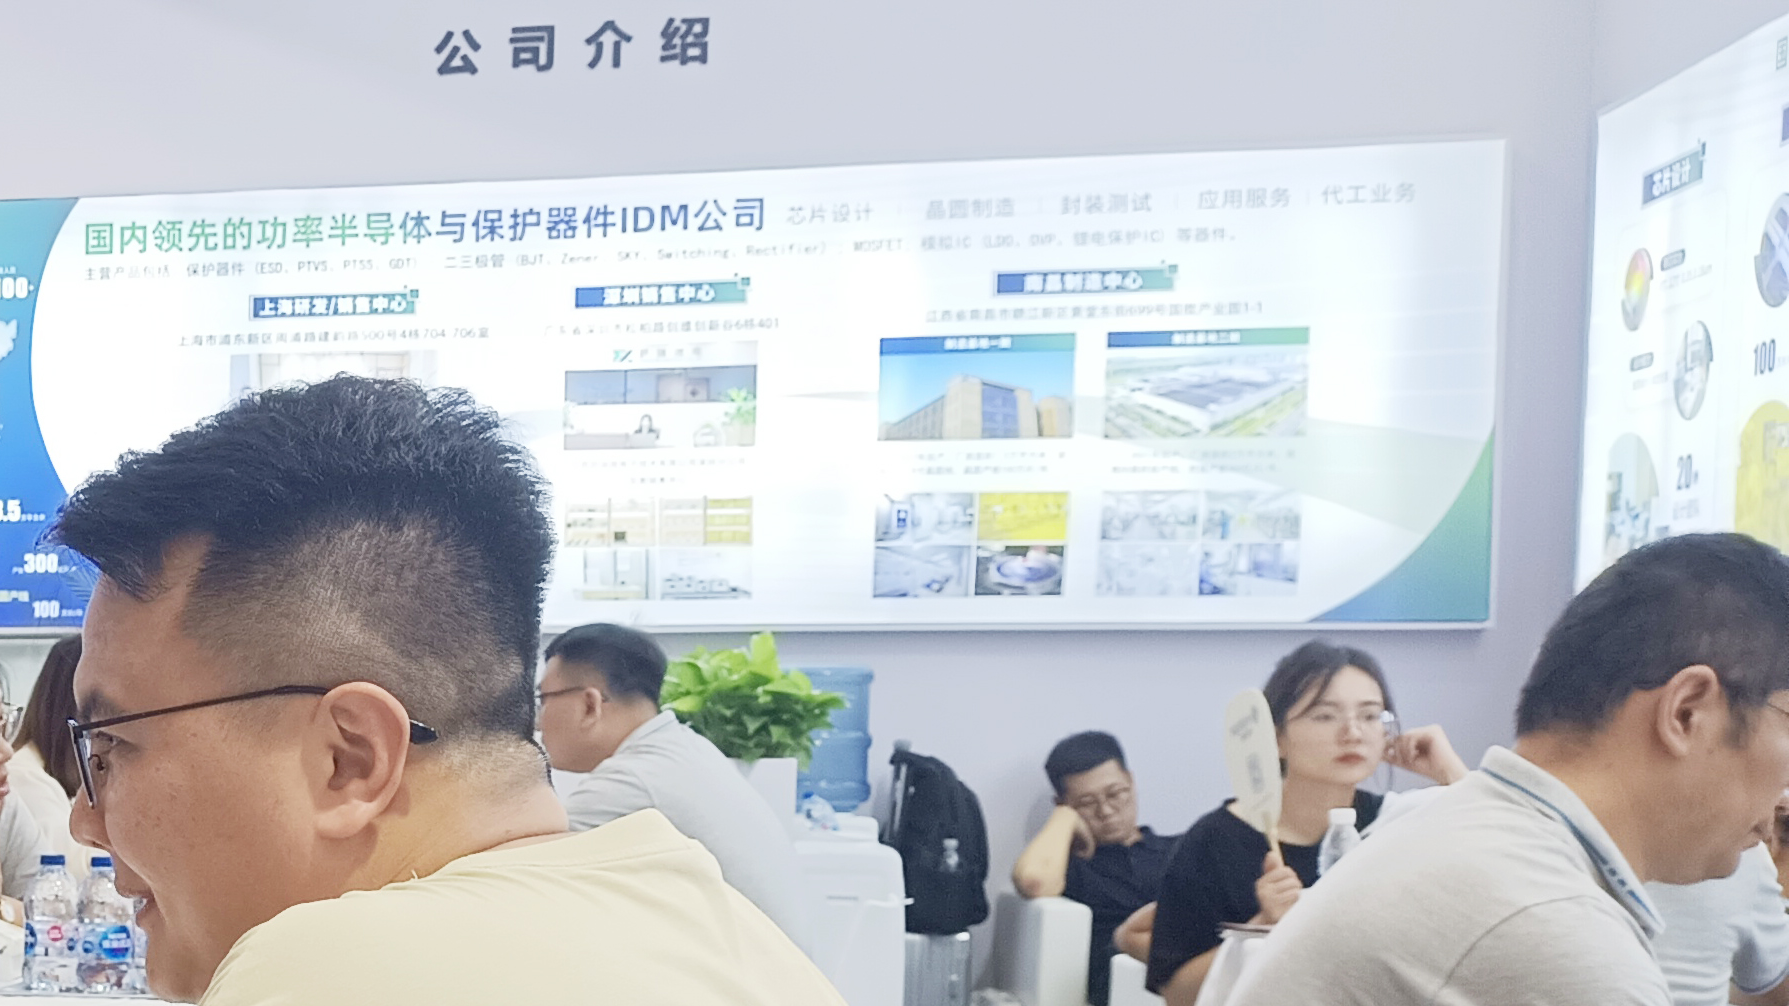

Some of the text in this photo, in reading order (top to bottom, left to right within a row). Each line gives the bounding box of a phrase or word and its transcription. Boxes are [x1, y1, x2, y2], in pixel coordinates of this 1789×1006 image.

[434, 17, 710, 75] 公司介绍
[84, 198, 765, 255] 国内领先的功率半导体与保护器件IDM公司
[786, 203, 874, 226] 芯片设计
[1197, 187, 1291, 210] 应用服务
[1321, 182, 1417, 205] 代工业务
[1754, 338, 1776, 376] 100
